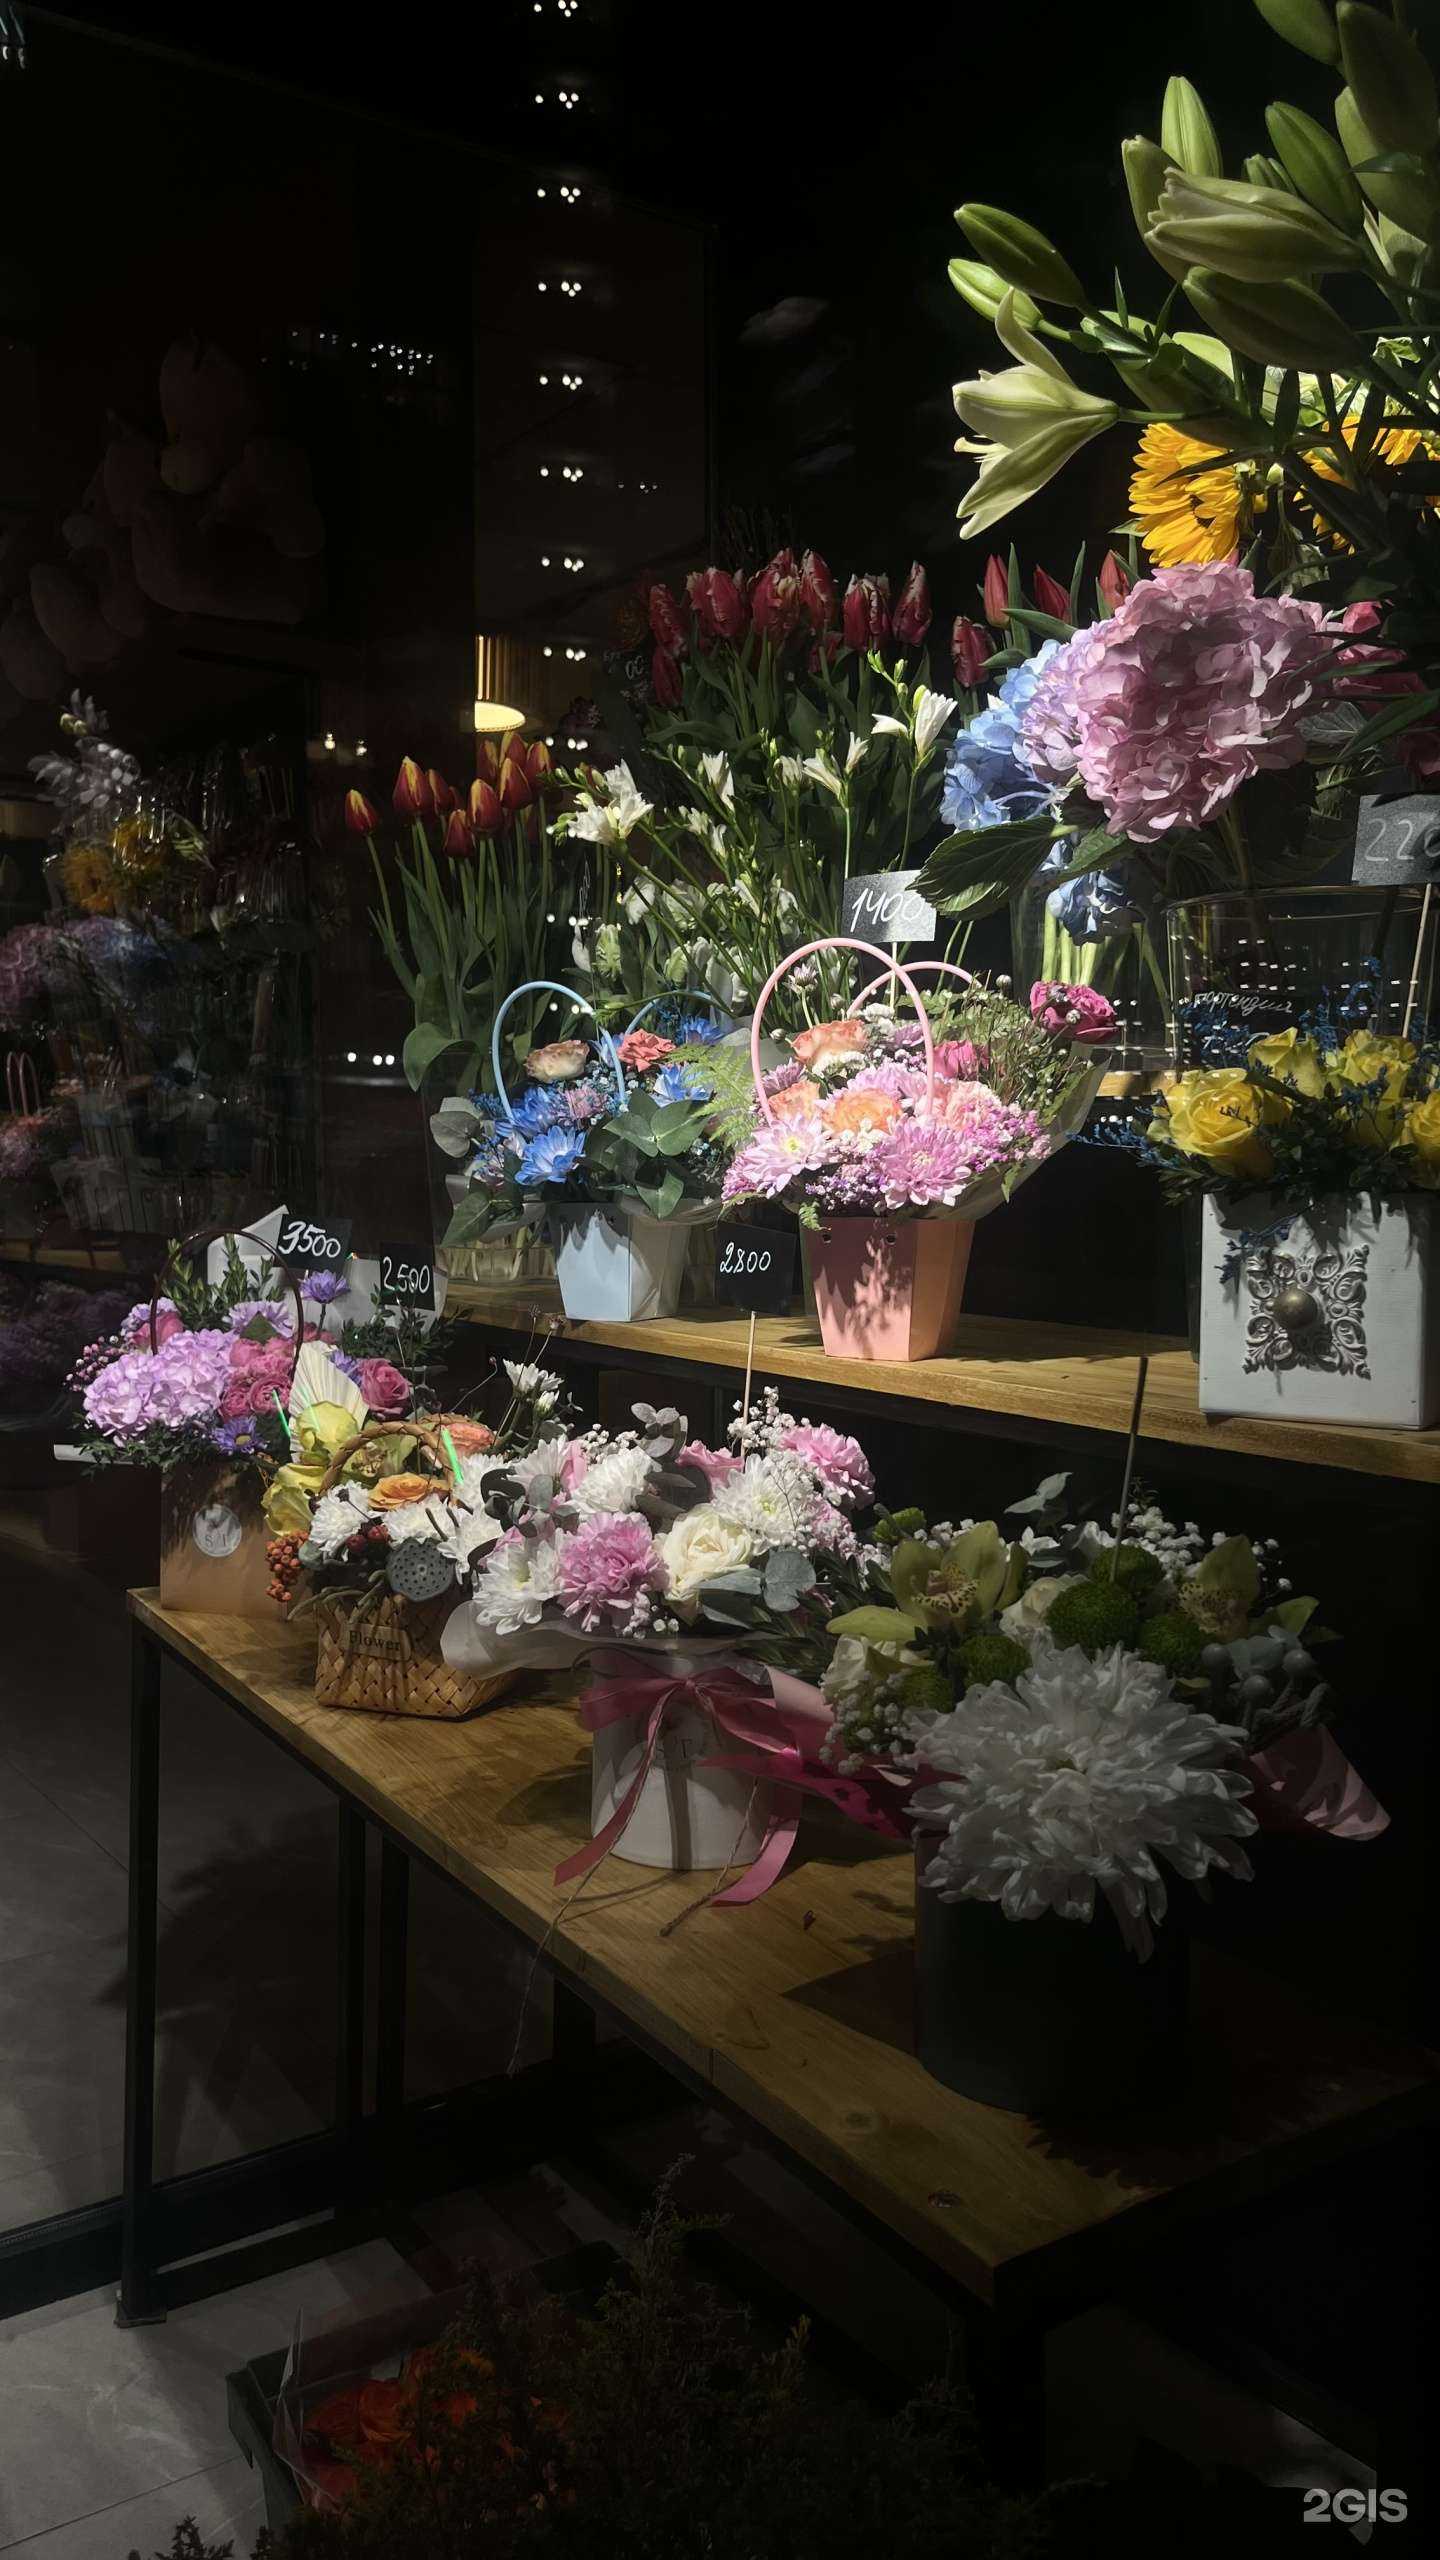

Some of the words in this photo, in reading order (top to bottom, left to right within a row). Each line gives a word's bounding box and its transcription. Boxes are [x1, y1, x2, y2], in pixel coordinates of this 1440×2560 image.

[851, 888, 924, 933] 1400
[278, 1221, 341, 1258] 3500
[719, 1242, 771, 1273] 2800
[382, 1256, 430, 1293] 2500
